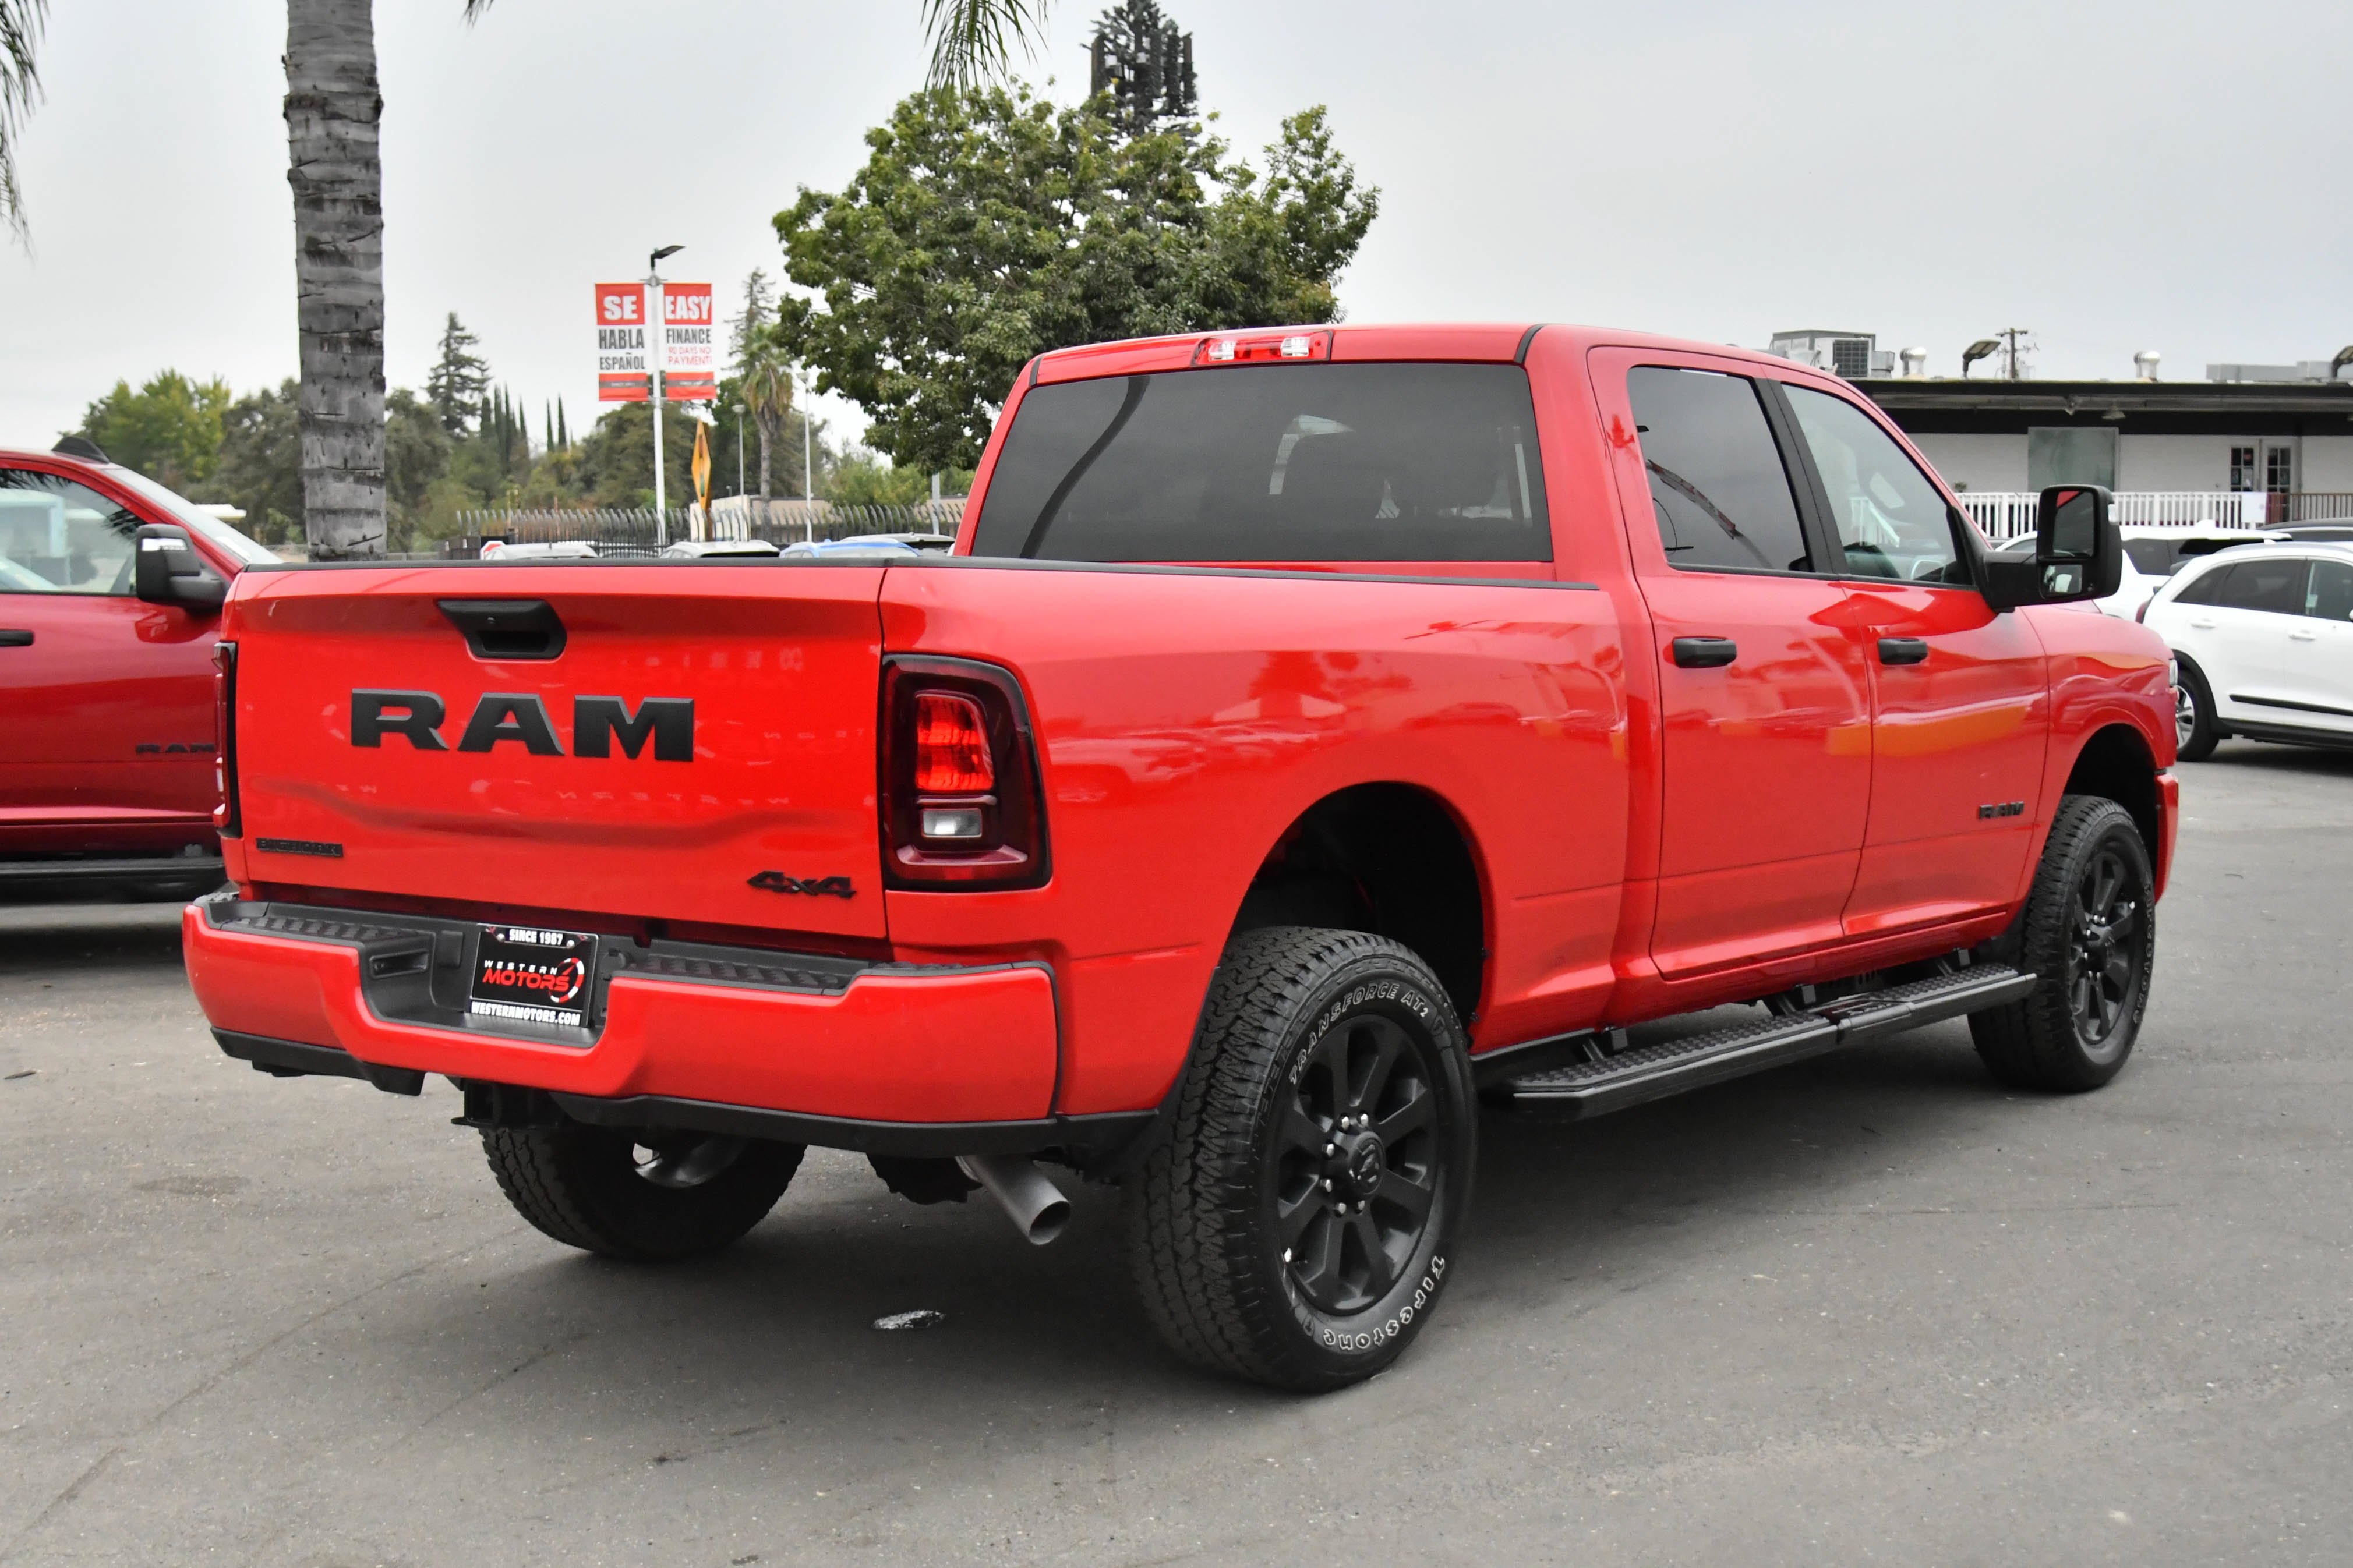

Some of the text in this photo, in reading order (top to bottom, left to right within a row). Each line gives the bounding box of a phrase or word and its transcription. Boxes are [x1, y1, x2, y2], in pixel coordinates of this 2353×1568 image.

[603, 295, 638, 321] SE
[665, 295, 712, 320] EASY
[599, 328, 645, 349] HABLA
[666, 328, 711, 344] FINANCE
[699, 346, 712, 355] NO
[600, 352, 645, 370] ESPAÑOL
[351, 688, 694, 762] RAM
[136, 743, 215, 754] RAM
[1979, 801, 2025, 819] RAM
[509, 928, 563, 946] SINCE 1987
[484, 960, 558, 975] WESTERN
[482, 967, 570, 993] MOTORS
[471, 1001, 581, 1026] WESTERNMOTORS.COM
[1289, 982, 1400, 1085] TRANSFORCE
